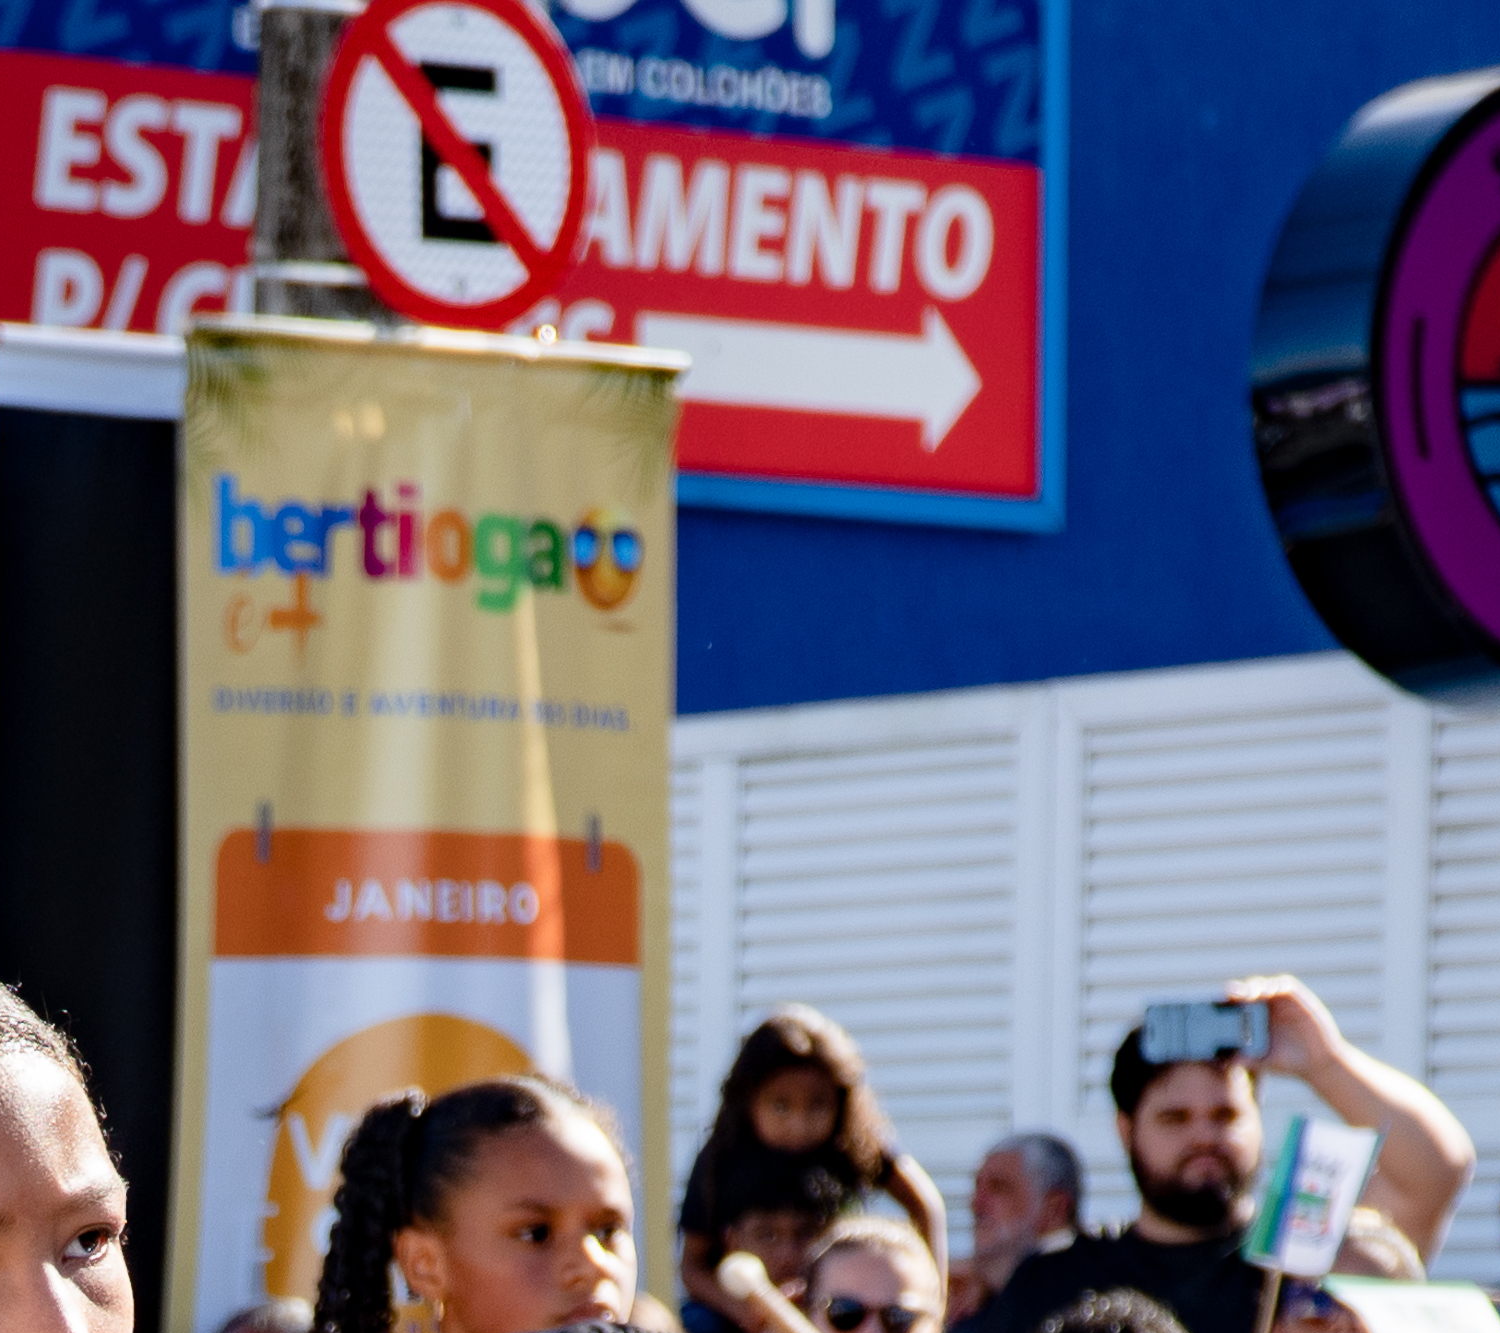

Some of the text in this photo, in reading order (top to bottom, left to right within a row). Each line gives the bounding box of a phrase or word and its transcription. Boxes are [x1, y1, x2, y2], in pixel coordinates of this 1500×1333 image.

[420, 63, 498, 244] E
[214, 473, 568, 614] bertioga
[326, 877, 541, 926] JANEIRO
